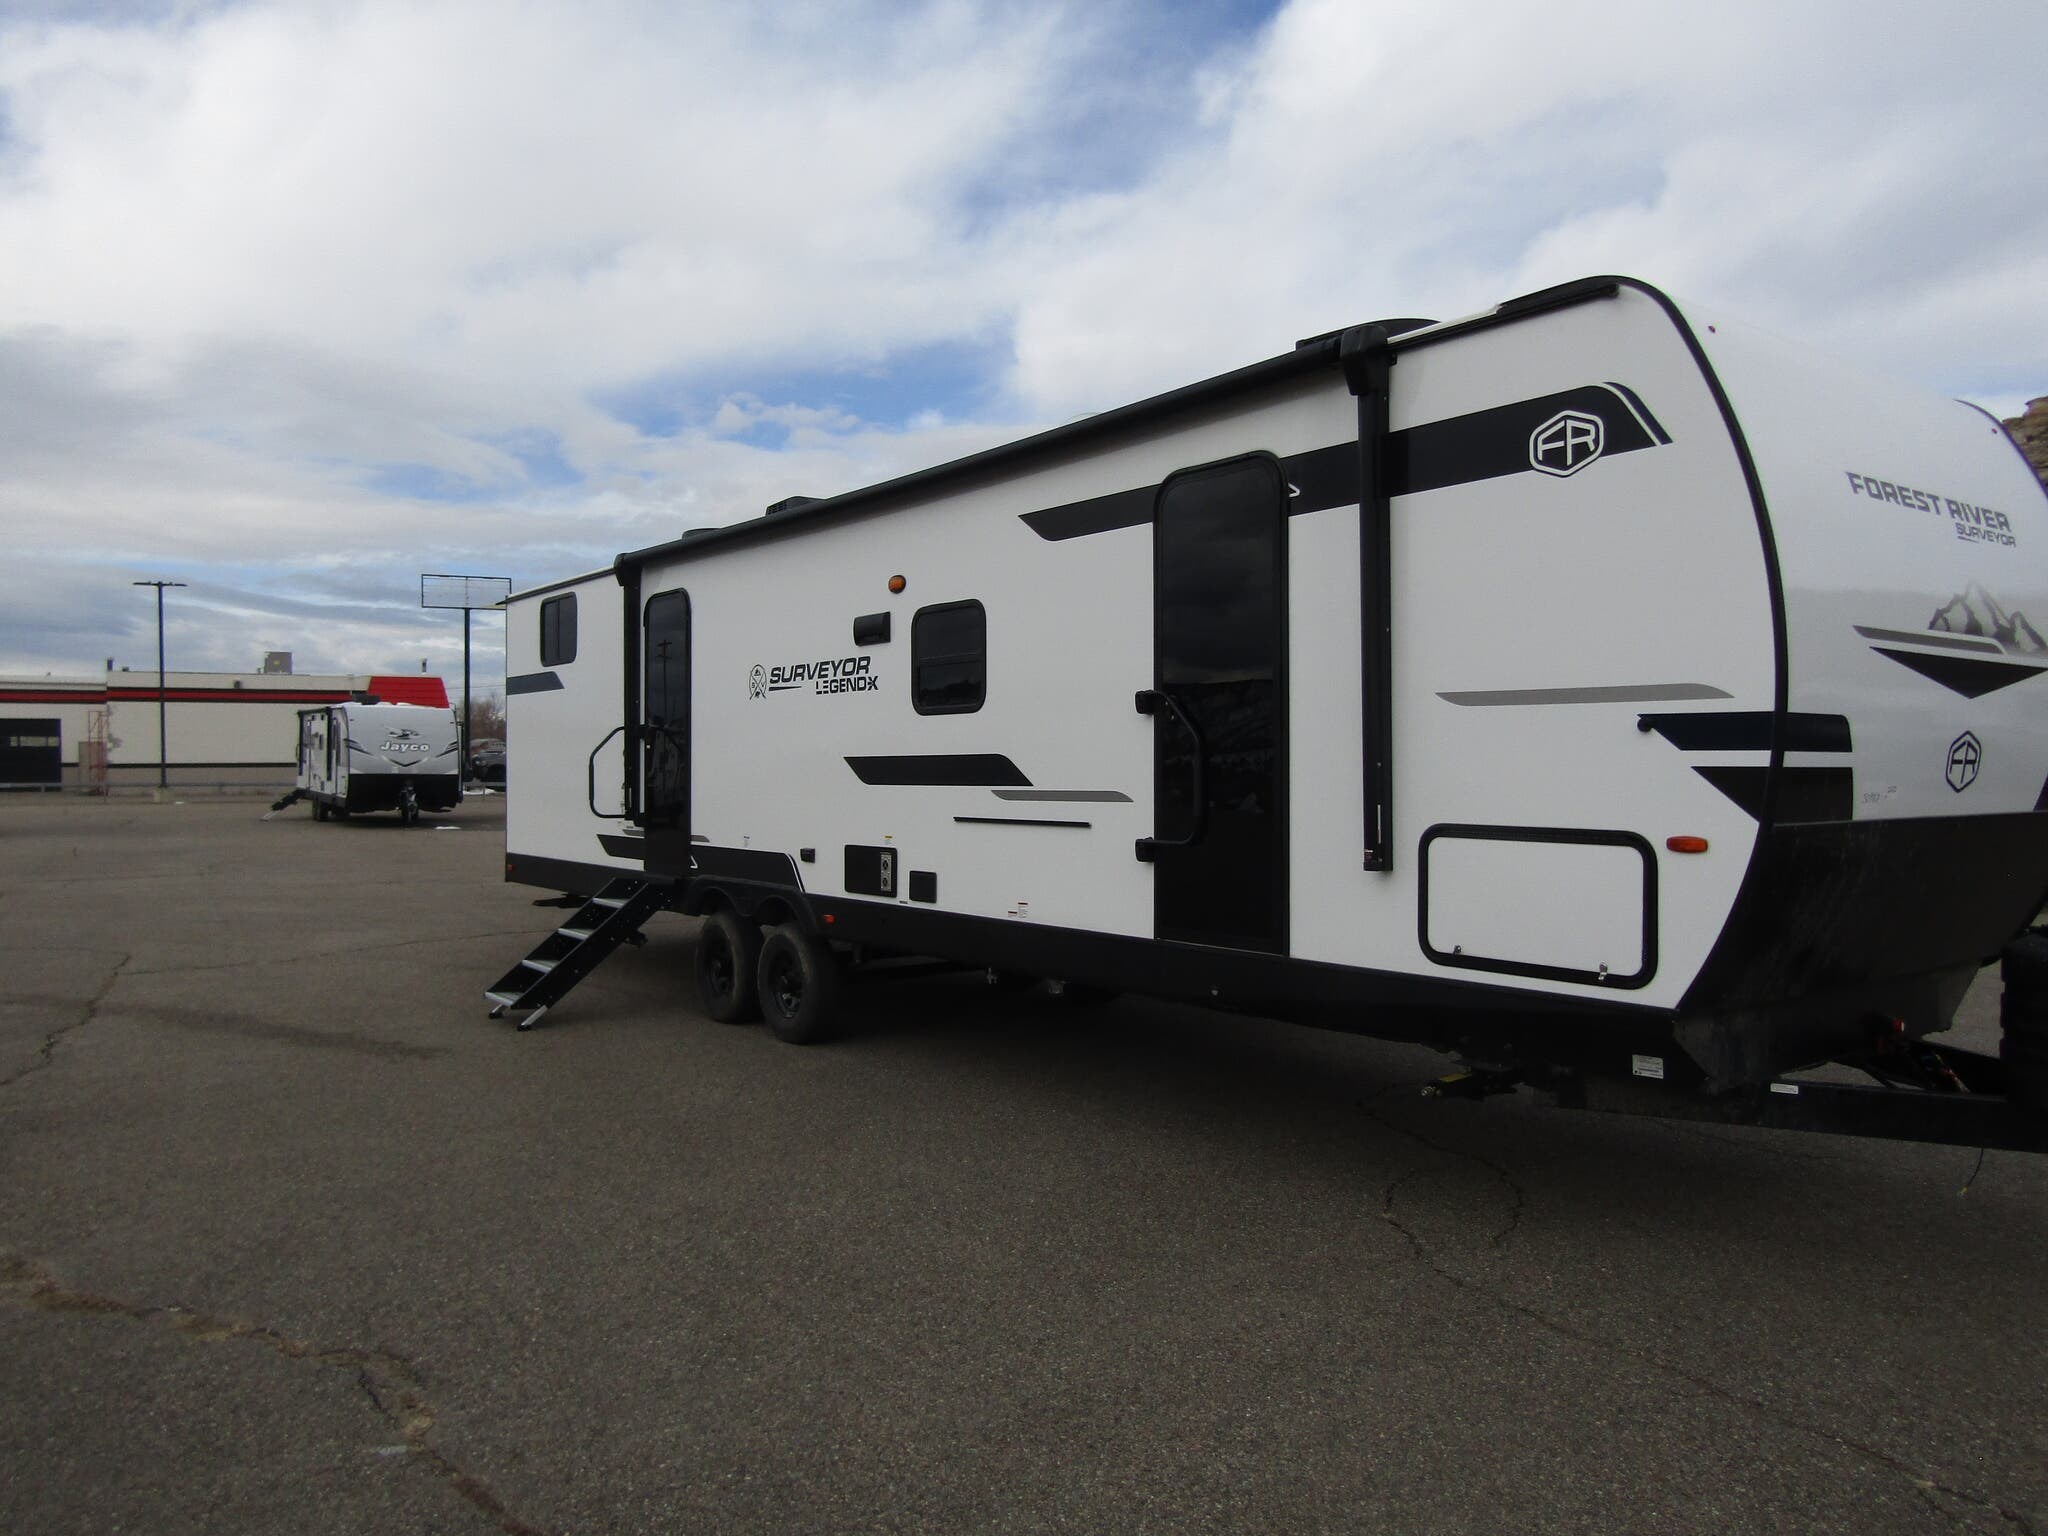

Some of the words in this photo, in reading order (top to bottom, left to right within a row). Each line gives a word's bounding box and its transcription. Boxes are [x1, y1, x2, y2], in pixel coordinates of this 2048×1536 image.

[1537, 419, 1596, 467] FR
[1845, 471, 1942, 516] FOREST
[1944, 498, 2012, 532] RIVER
[1955, 521, 2017, 548] SURVEYOR
[769, 655, 871, 684] SURVEYOR
[380, 740, 431, 754] Jayco
